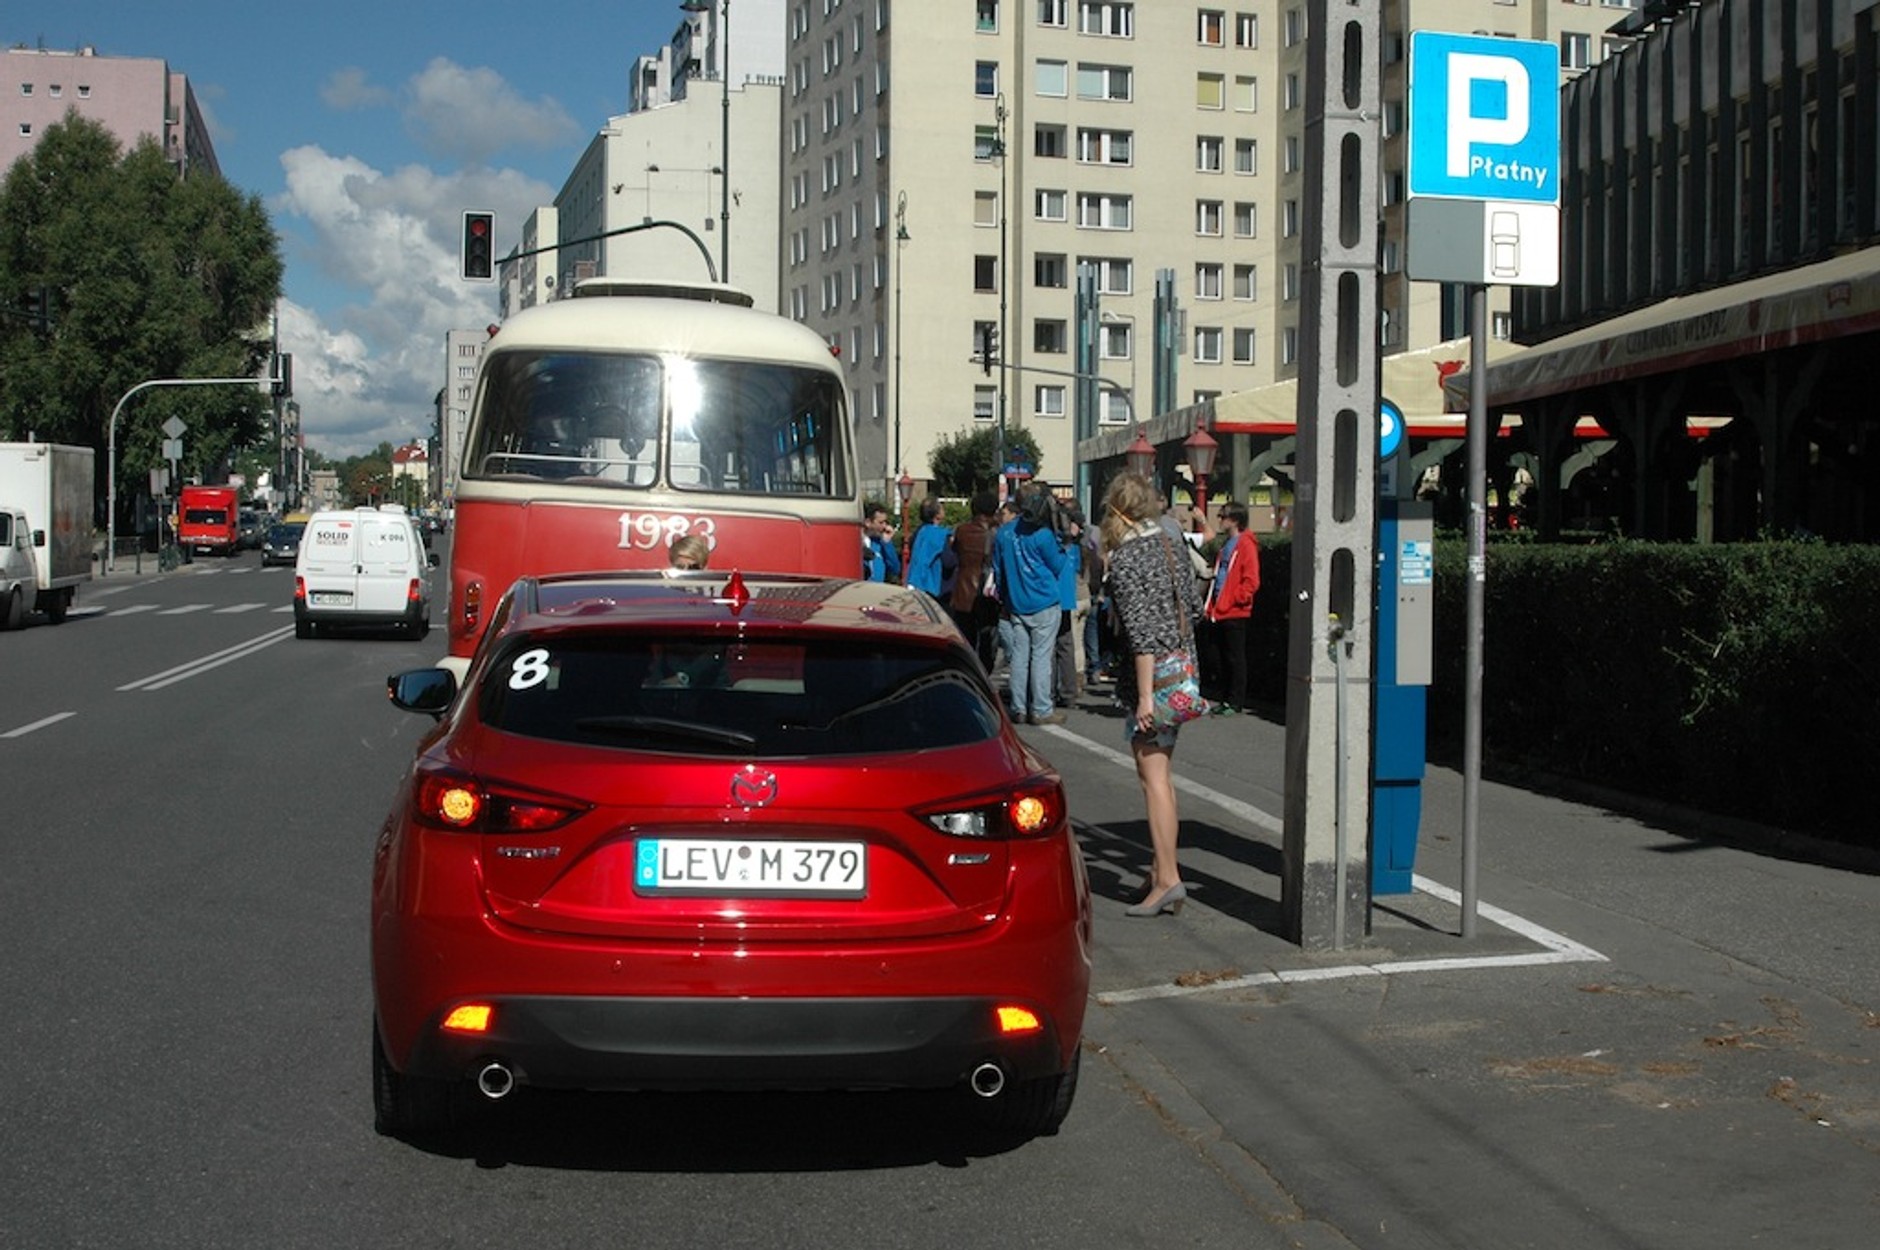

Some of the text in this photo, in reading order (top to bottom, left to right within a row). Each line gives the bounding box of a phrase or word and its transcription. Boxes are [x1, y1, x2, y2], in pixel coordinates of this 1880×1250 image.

[1447, 52, 1531, 178] P
[1470, 155, 1548, 190] Płatny
[317, 531, 349, 540] SOLID
[617, 512, 717, 552] 1983
[508, 648, 550, 690] 8
[661, 847, 733, 881] LEV
[760, 848, 782, 882] M
[792, 848, 860, 883] 379
